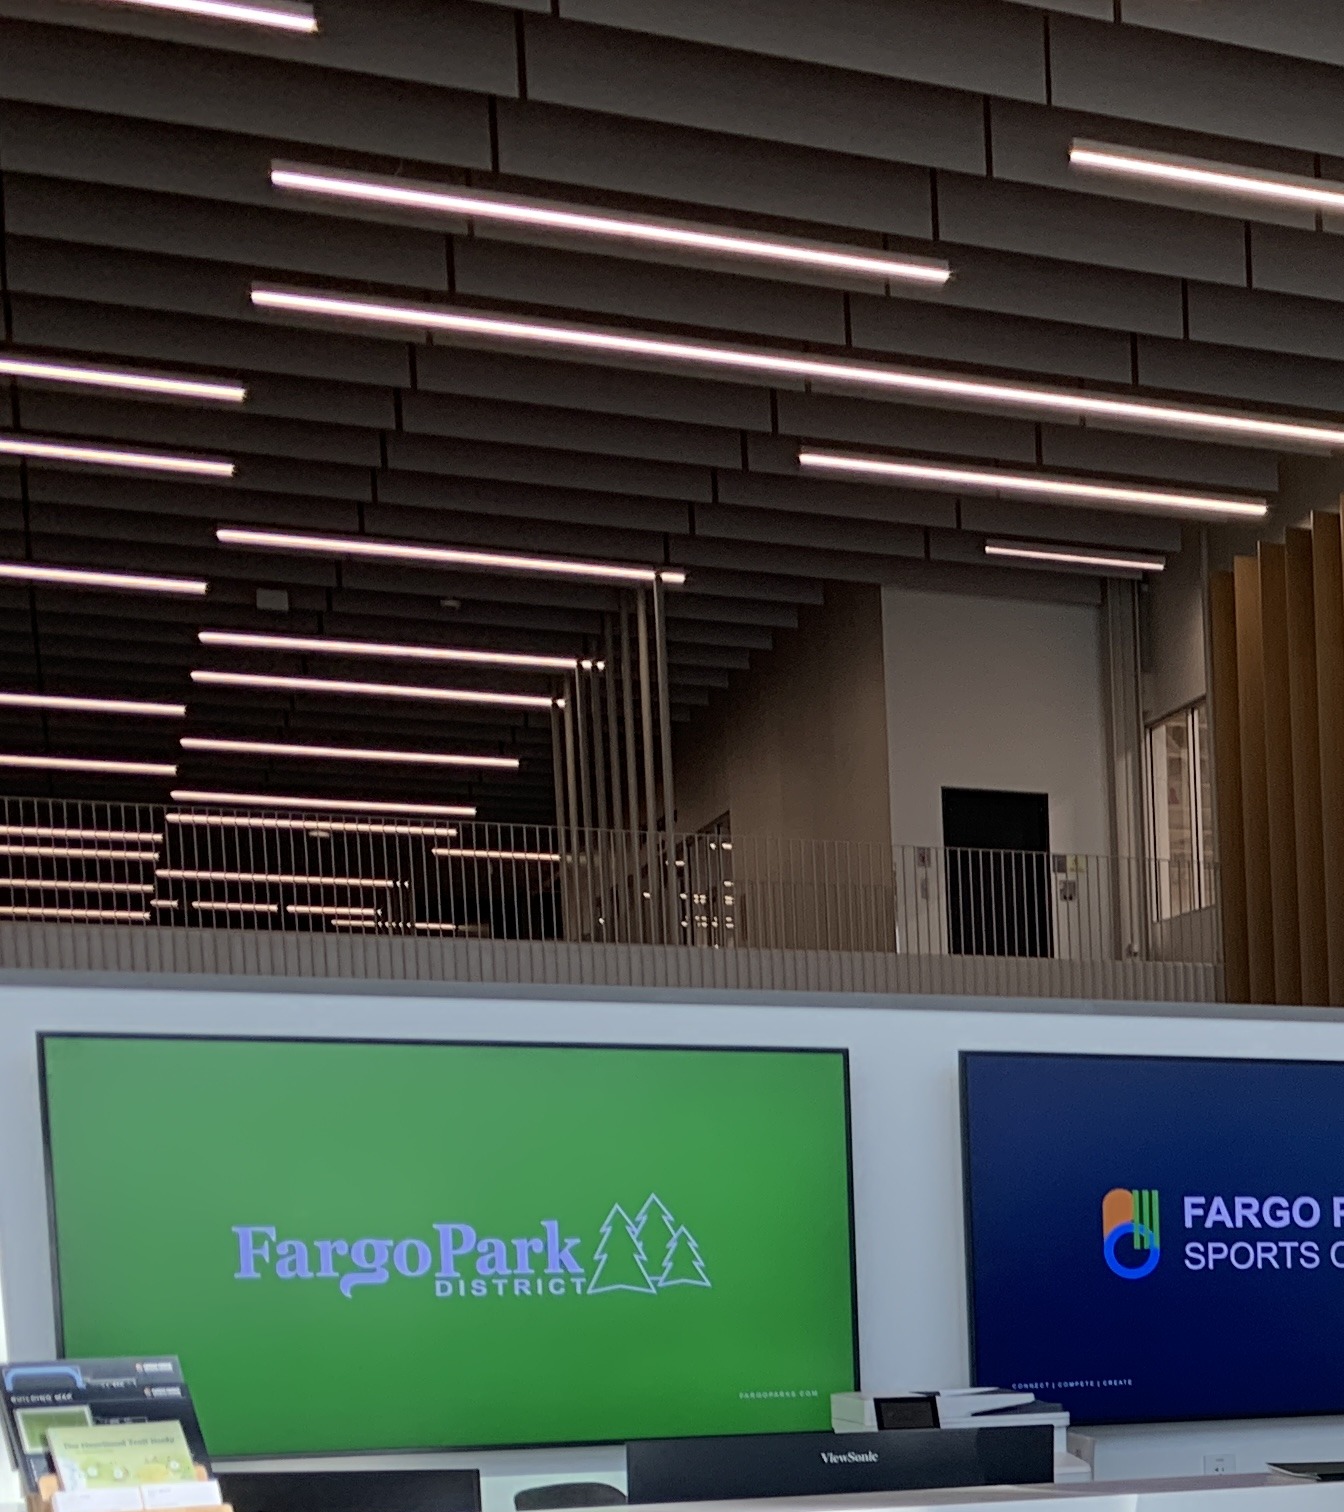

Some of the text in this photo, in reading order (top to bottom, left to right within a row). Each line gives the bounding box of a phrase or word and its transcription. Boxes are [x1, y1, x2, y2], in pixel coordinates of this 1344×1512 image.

[1183, 1195, 1321, 1229] FARGO
[231, 1220, 585, 1299] FargoPark
[1184, 1241, 1320, 1270] SPORTS
[434, 1277, 587, 1297] DISTRICT
[1011, 1378, 1133, 1390] CONNECT COMPETE CREATE
[820, 1450, 878, 1464] ViewSonic
